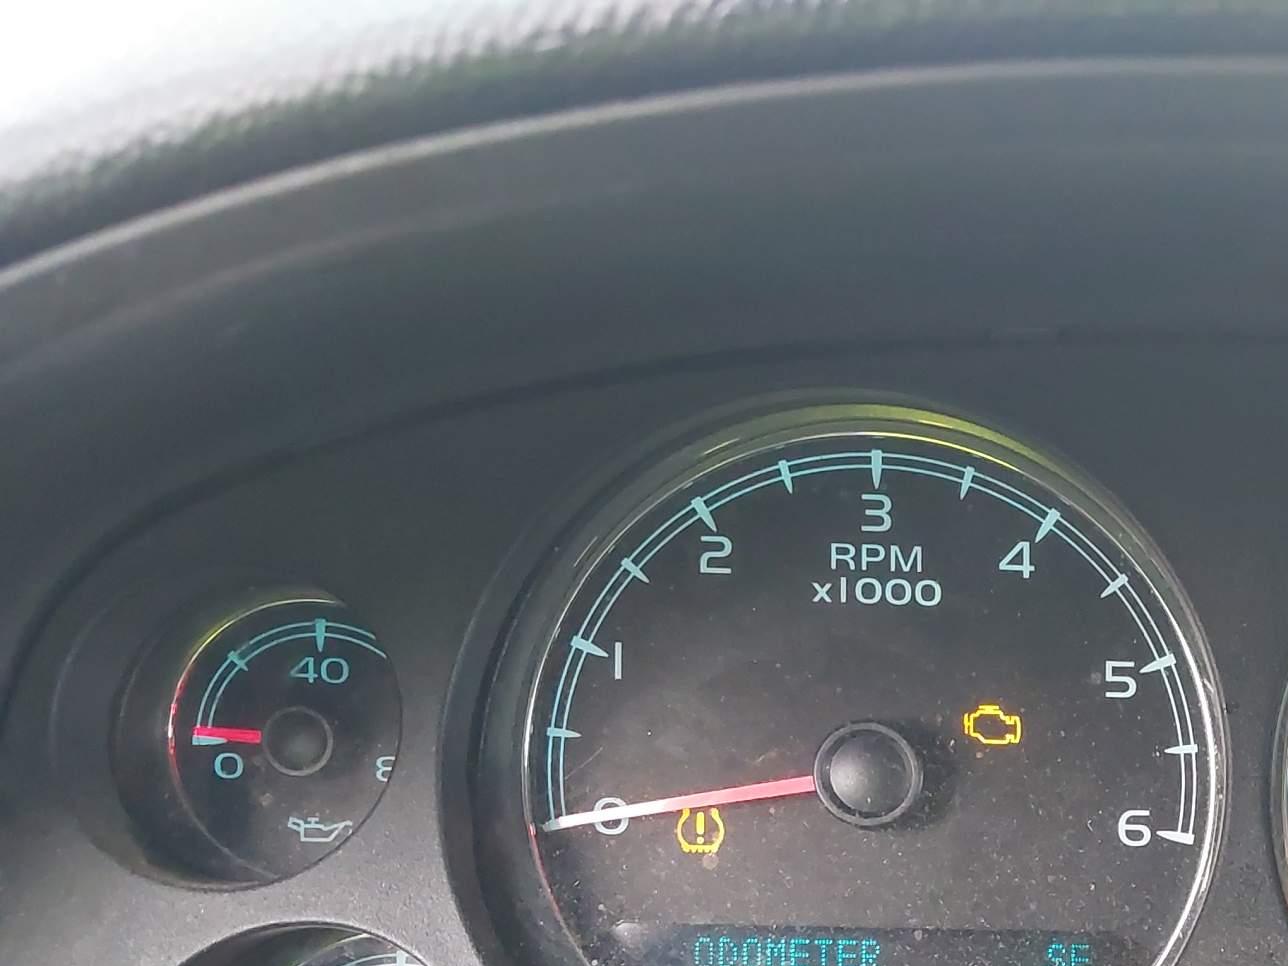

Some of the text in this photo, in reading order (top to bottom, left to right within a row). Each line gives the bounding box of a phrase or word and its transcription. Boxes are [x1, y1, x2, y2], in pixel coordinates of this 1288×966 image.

[859, 493, 893, 532] 3
[699, 535, 733, 575] 2
[830, 542, 924, 573] RPM
[999, 542, 1035, 578] 4
[811, 577, 942, 606] x1000
[290, 656, 349, 684] 40
[1104, 660, 1137, 699] 5
[214, 753, 243, 779] 0
[593, 797, 629, 835] 0
[1118, 810, 1151, 846] 6
